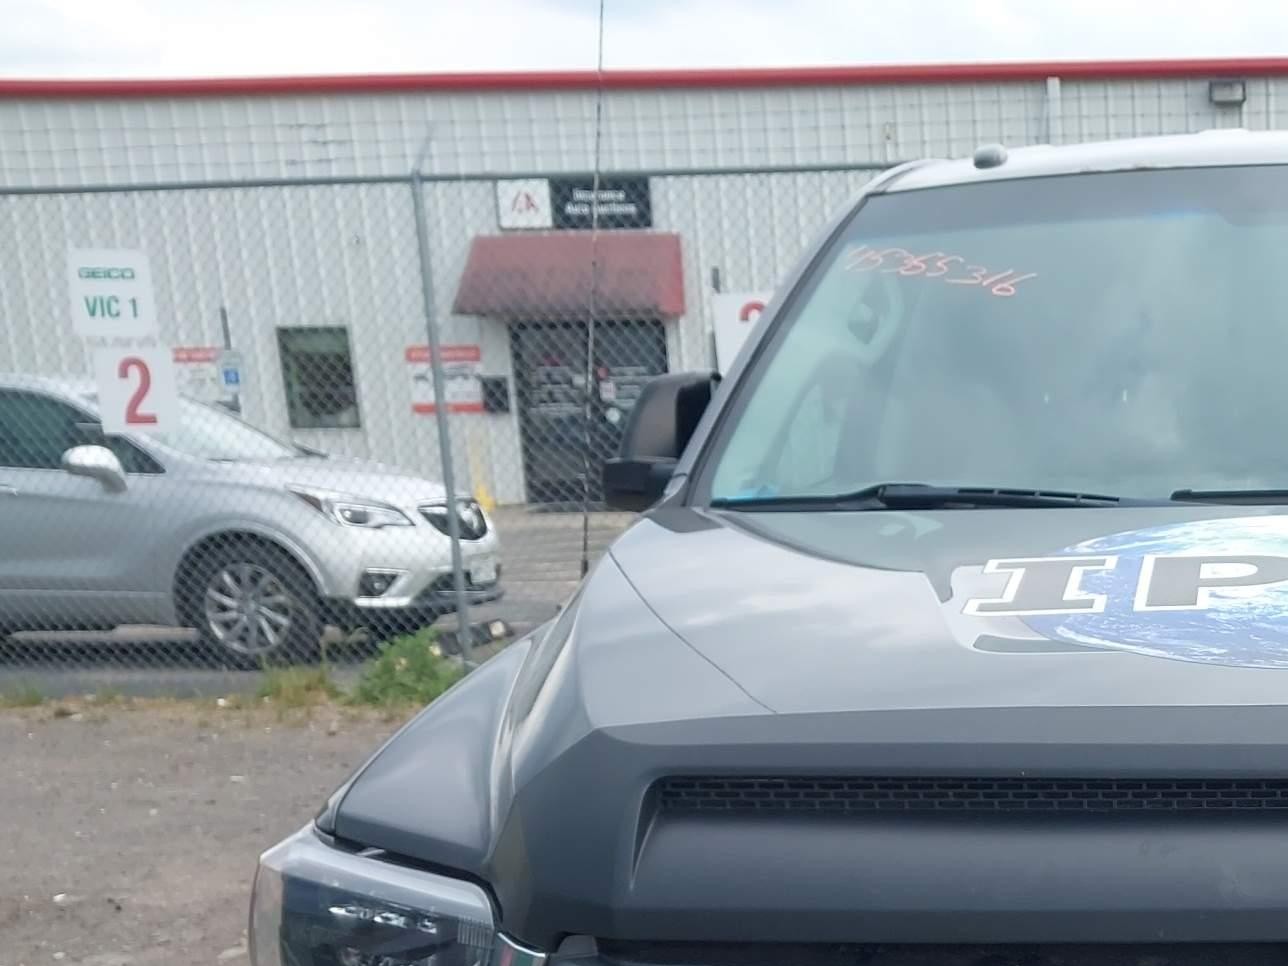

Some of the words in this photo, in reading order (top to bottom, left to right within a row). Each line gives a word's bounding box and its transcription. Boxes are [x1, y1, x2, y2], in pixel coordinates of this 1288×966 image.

[78, 267, 135, 279] GEICO
[85, 295, 120, 318] VIC
[129, 297, 138, 318] 1
[118, 357, 158, 424] 2
